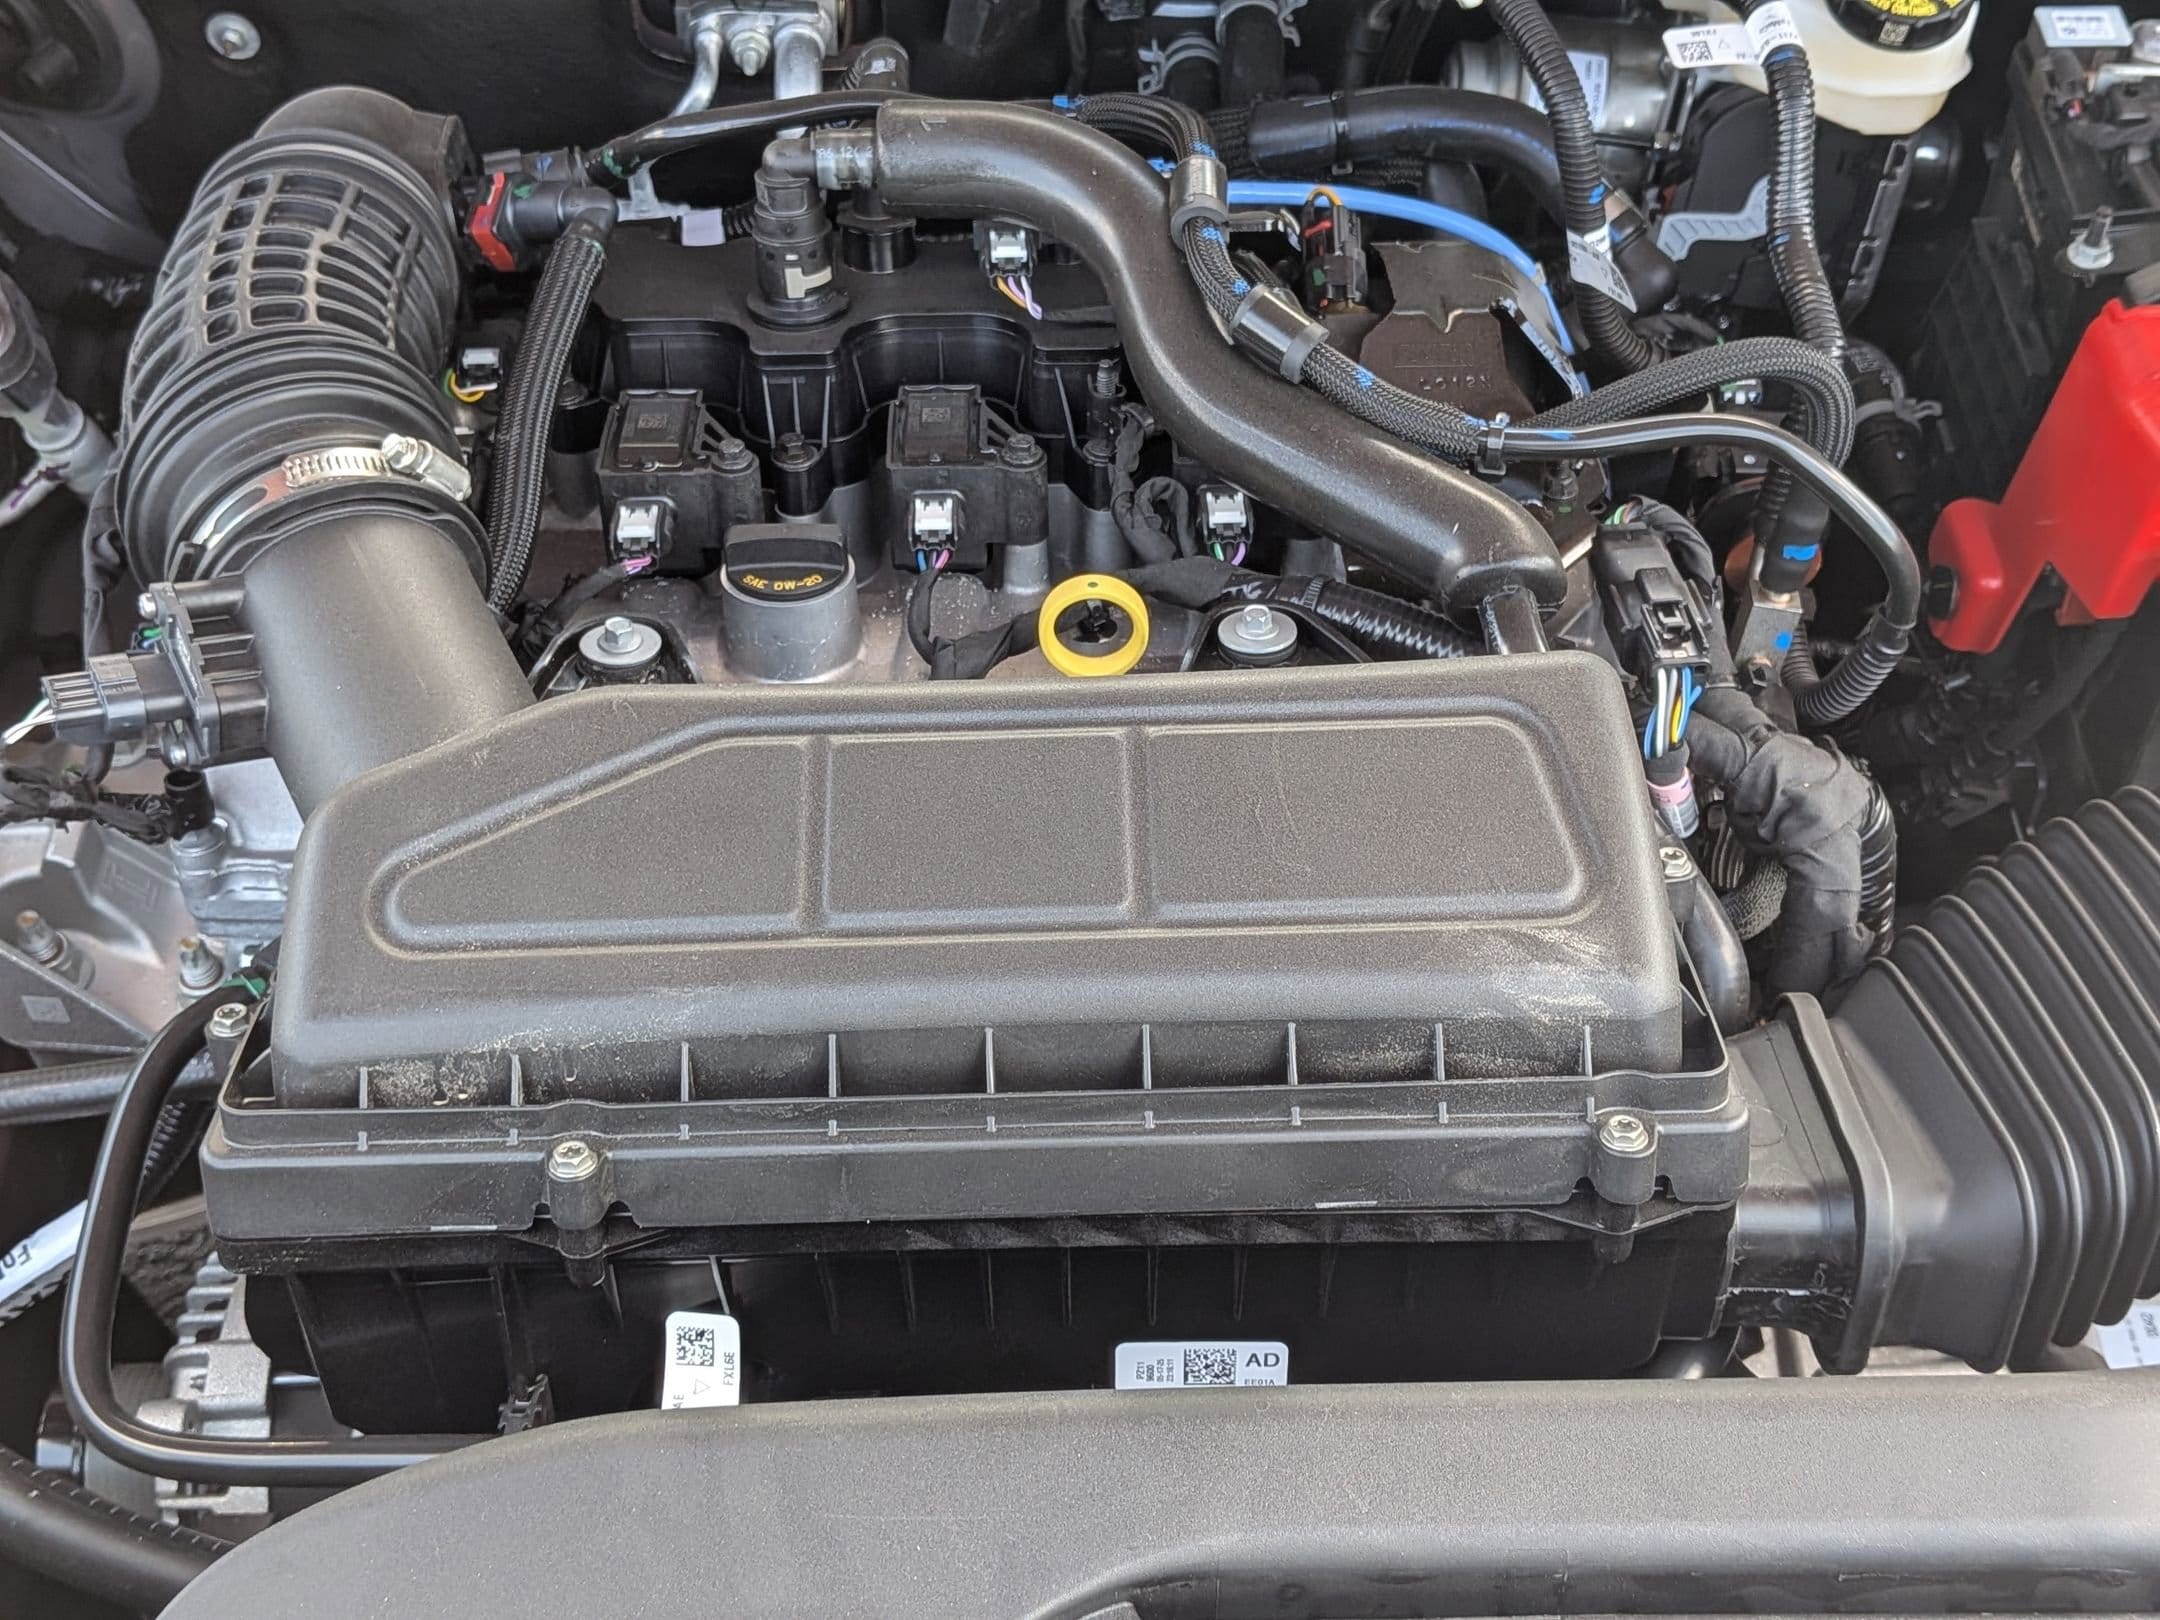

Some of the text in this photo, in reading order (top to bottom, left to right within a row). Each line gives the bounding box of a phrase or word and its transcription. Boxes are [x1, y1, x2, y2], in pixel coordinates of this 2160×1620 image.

[743, 573, 823, 591] SAE 0W-20
[723, 1352, 735, 1386] FXL6E
[1245, 1352, 1281, 1368] AD
